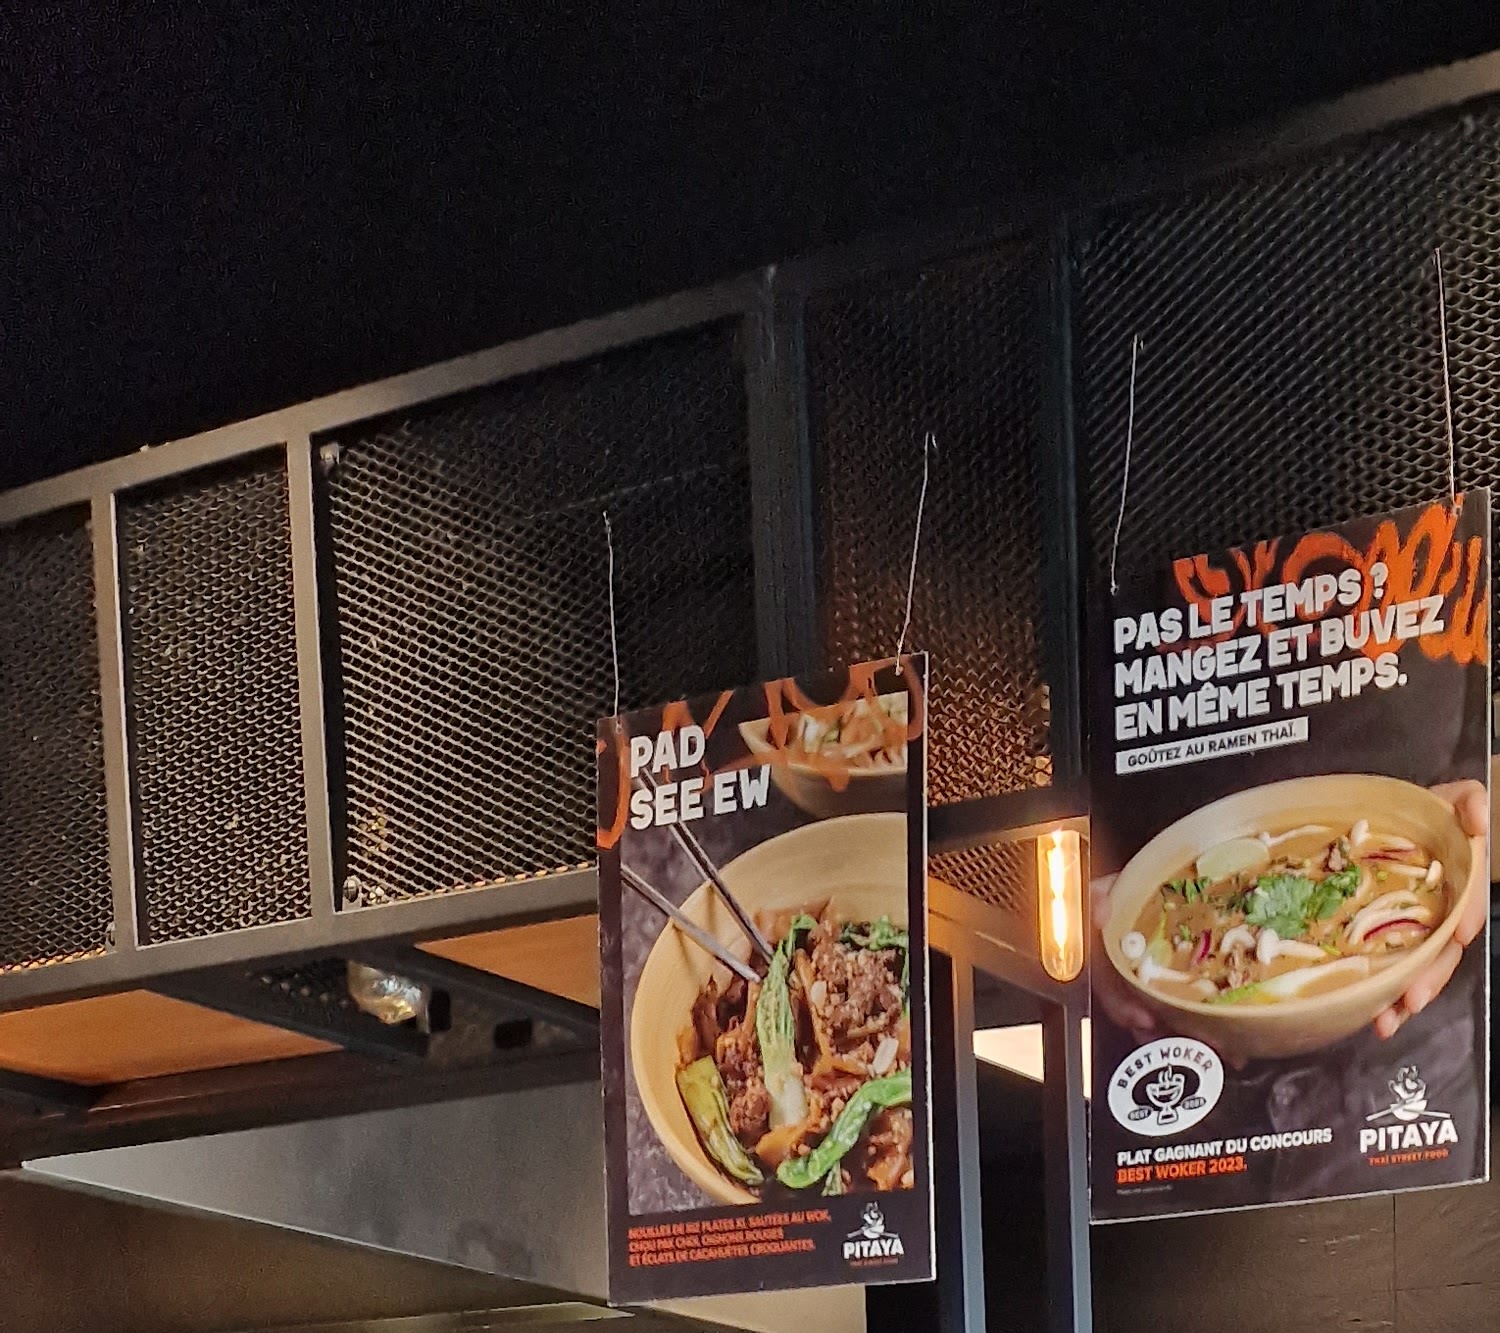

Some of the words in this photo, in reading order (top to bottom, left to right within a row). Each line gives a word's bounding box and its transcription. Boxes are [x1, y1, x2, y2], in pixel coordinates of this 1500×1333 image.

[1114, 608, 1182, 654] PAS
[1189, 596, 1234, 640] LE
[1240, 569, 1361, 627] TEMPS
[1369, 562, 1388, 599] ?
[1114, 636, 1262, 698] MANGEZ
[1268, 622, 1313, 668] ET
[1320, 595, 1444, 655] BUVEZ
[1115, 699, 1163, 741] EN
[1168, 680, 1270, 732] MÊME
[1277, 652, 1408, 709] TEMPS.
[630, 724, 706, 778] PAD
[1127, 744, 1181, 768] GOÛTEZ
[1185, 742, 1205, 758] AU
[1208, 733, 1258, 754] RAMEN
[630, 777, 705, 830] SEE
[714, 764, 772, 815] EW
[1117, 1052, 1152, 1089] BEST
[1160, 1047, 1213, 1072] WOKER
[1117, 1148, 1152, 1166] PLAT
[1155, 1141, 1223, 1163] GAGNANT
[1226, 1138, 1248, 1154] DU
[1250, 1128, 1333, 1152] CONCOURS
[1359, 1120, 1459, 1154] PITAYA
[1117, 1166, 1153, 1184] BEST
[1155, 1161, 1207, 1180] WOKER
[843, 1238, 905, 1259] PITAYA
